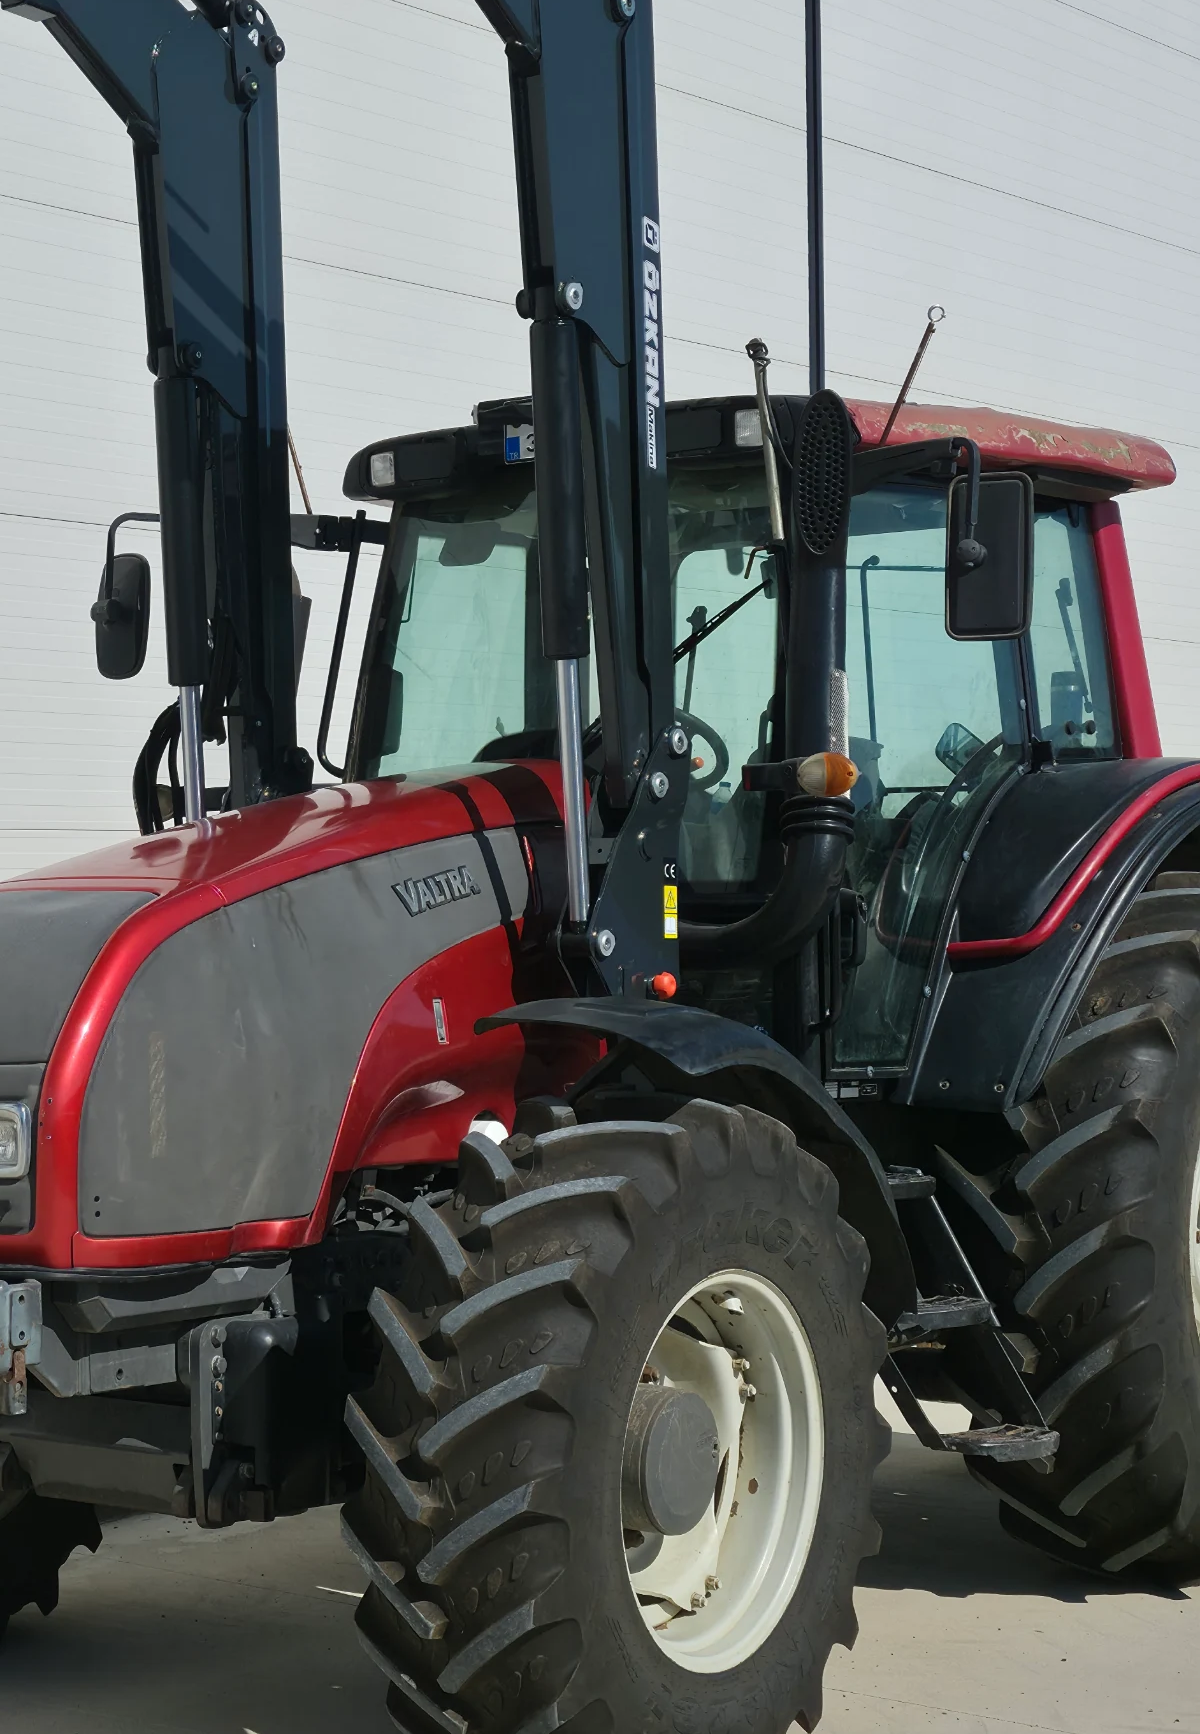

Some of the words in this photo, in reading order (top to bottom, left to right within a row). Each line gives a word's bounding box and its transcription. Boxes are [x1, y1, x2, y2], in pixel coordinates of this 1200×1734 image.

[643, 259, 660, 409] ÖZKAN
[509, 452, 519, 461] TR
[647, 407, 656, 466] Makina
[391, 864, 481, 918] VALTRA
[664, 863, 676, 879] CE
